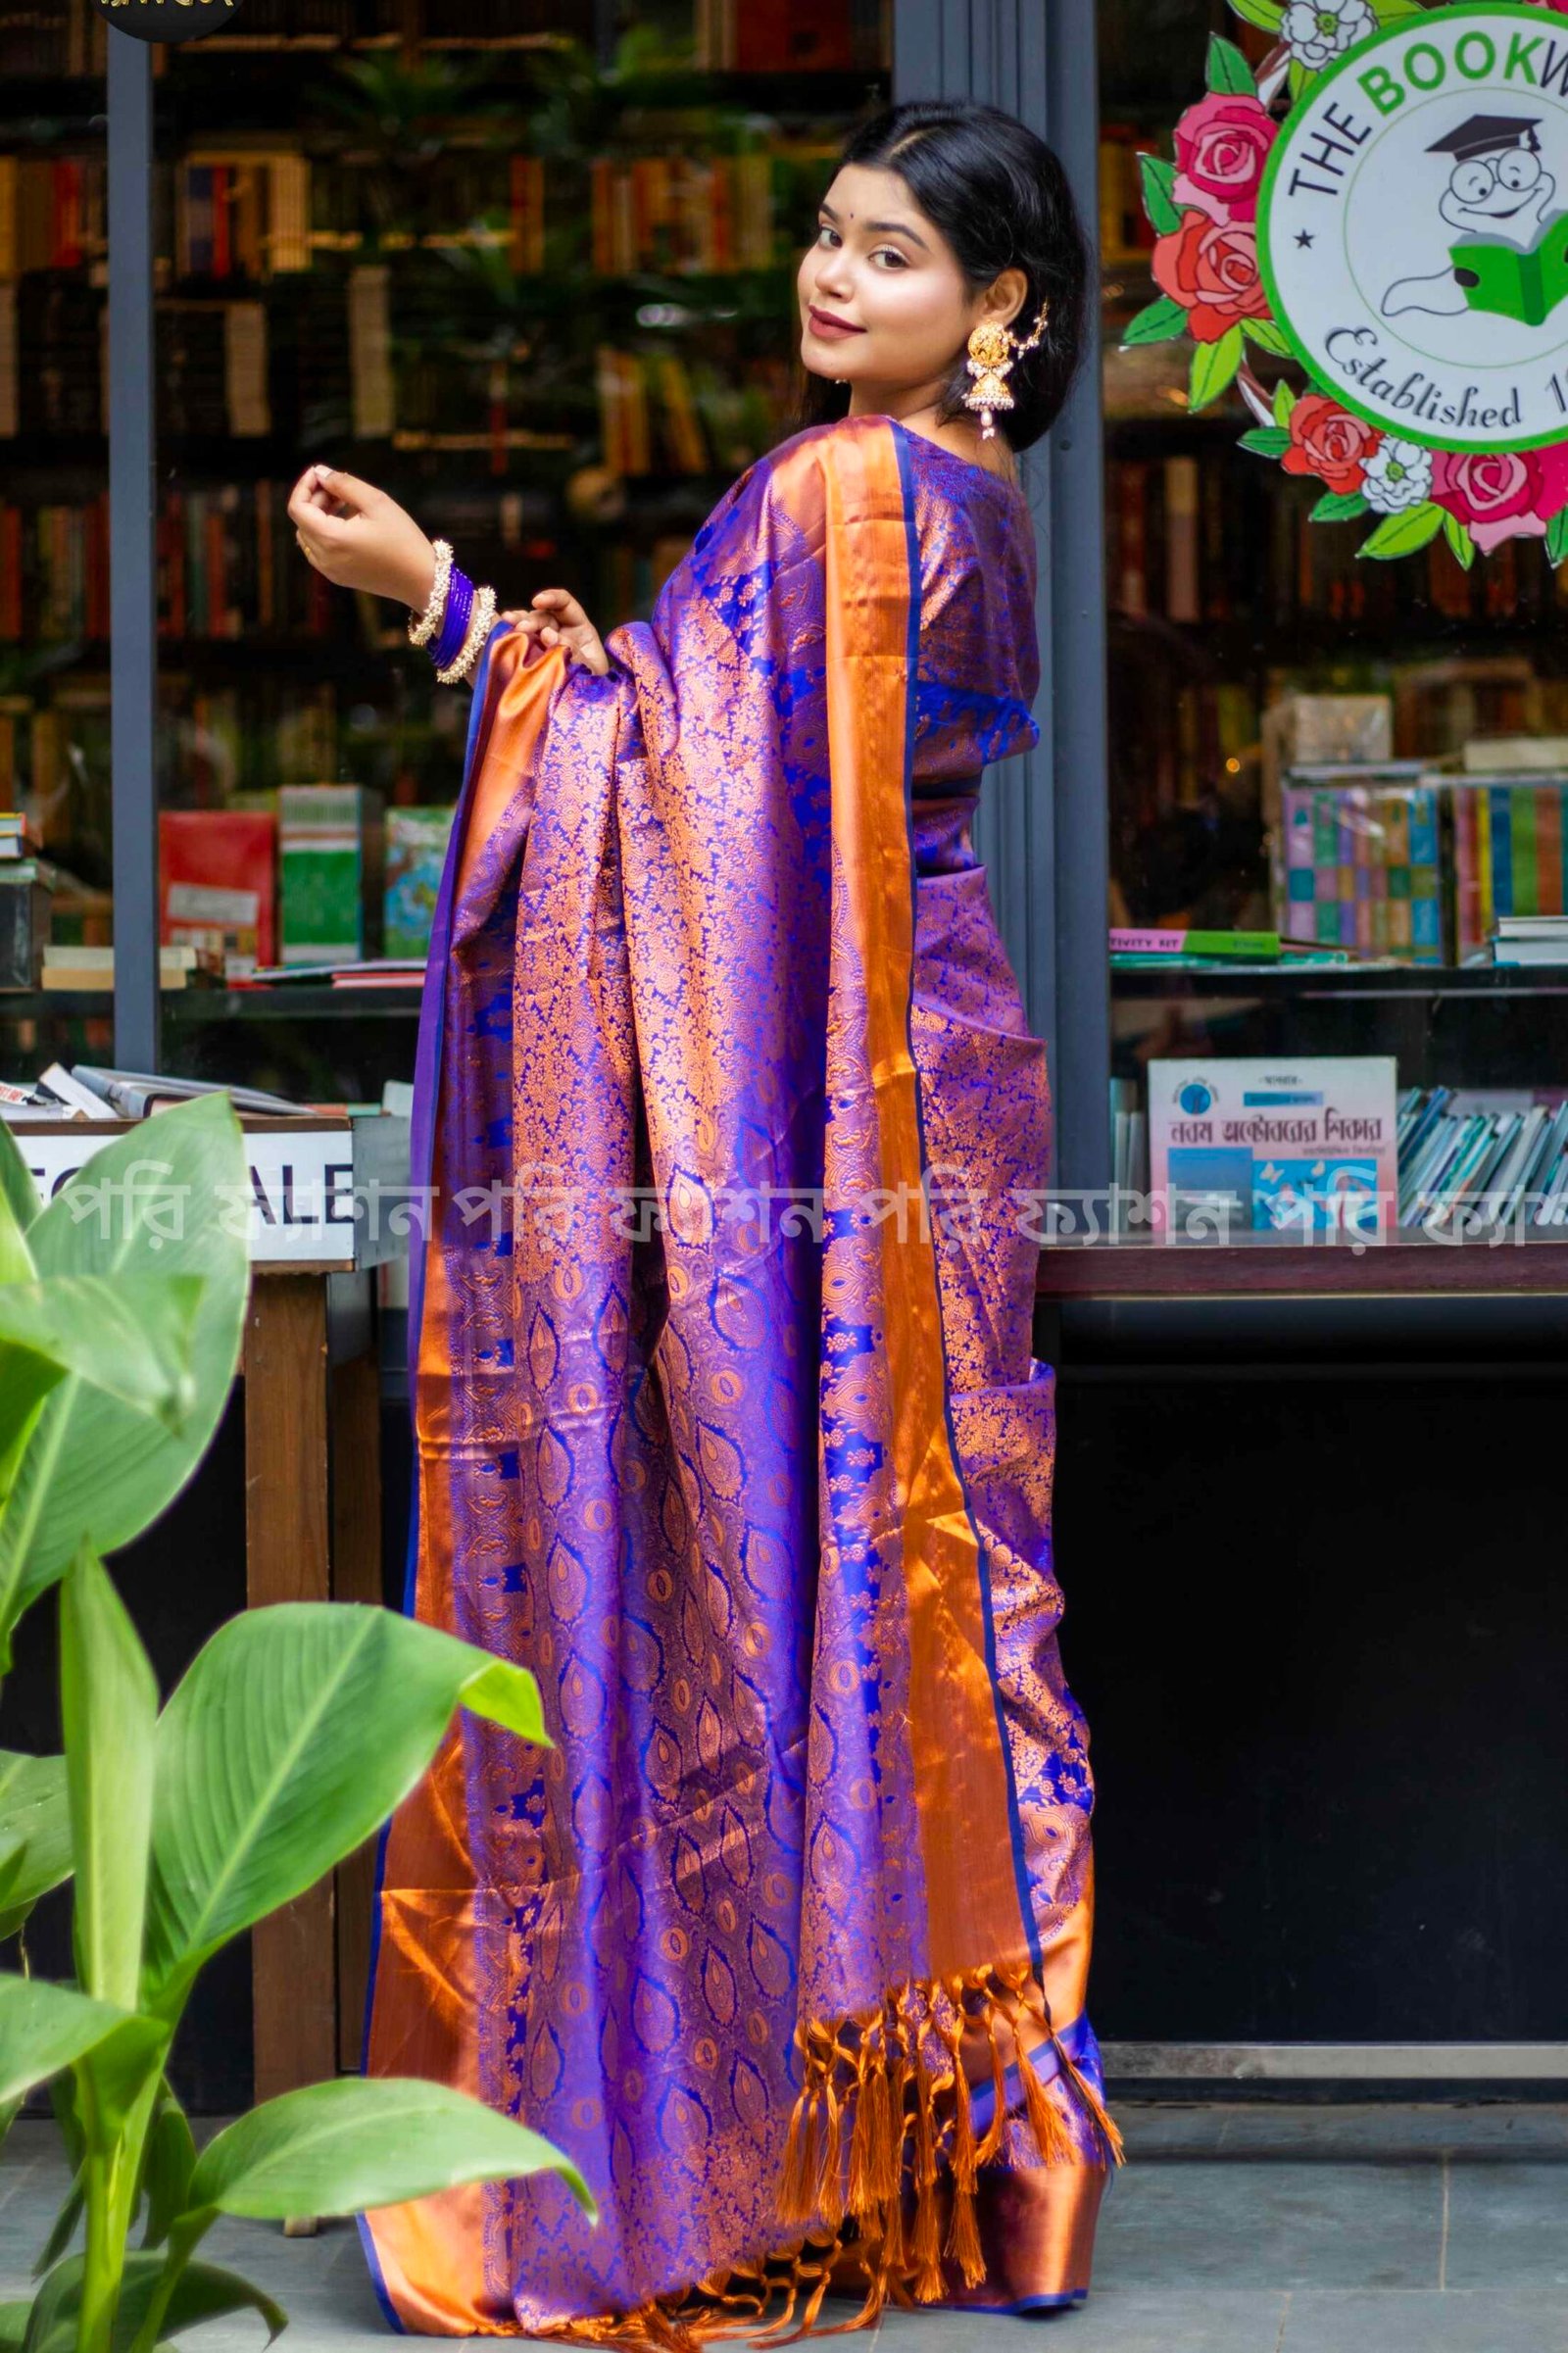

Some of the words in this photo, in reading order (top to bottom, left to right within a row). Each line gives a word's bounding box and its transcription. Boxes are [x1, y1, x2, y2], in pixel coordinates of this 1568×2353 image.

[1288, 102, 1372, 196] THE
[1324, 326, 1522, 427] Established
[1544, 368, 1568, 414] 1
[249, 1163, 354, 1225] ALE
